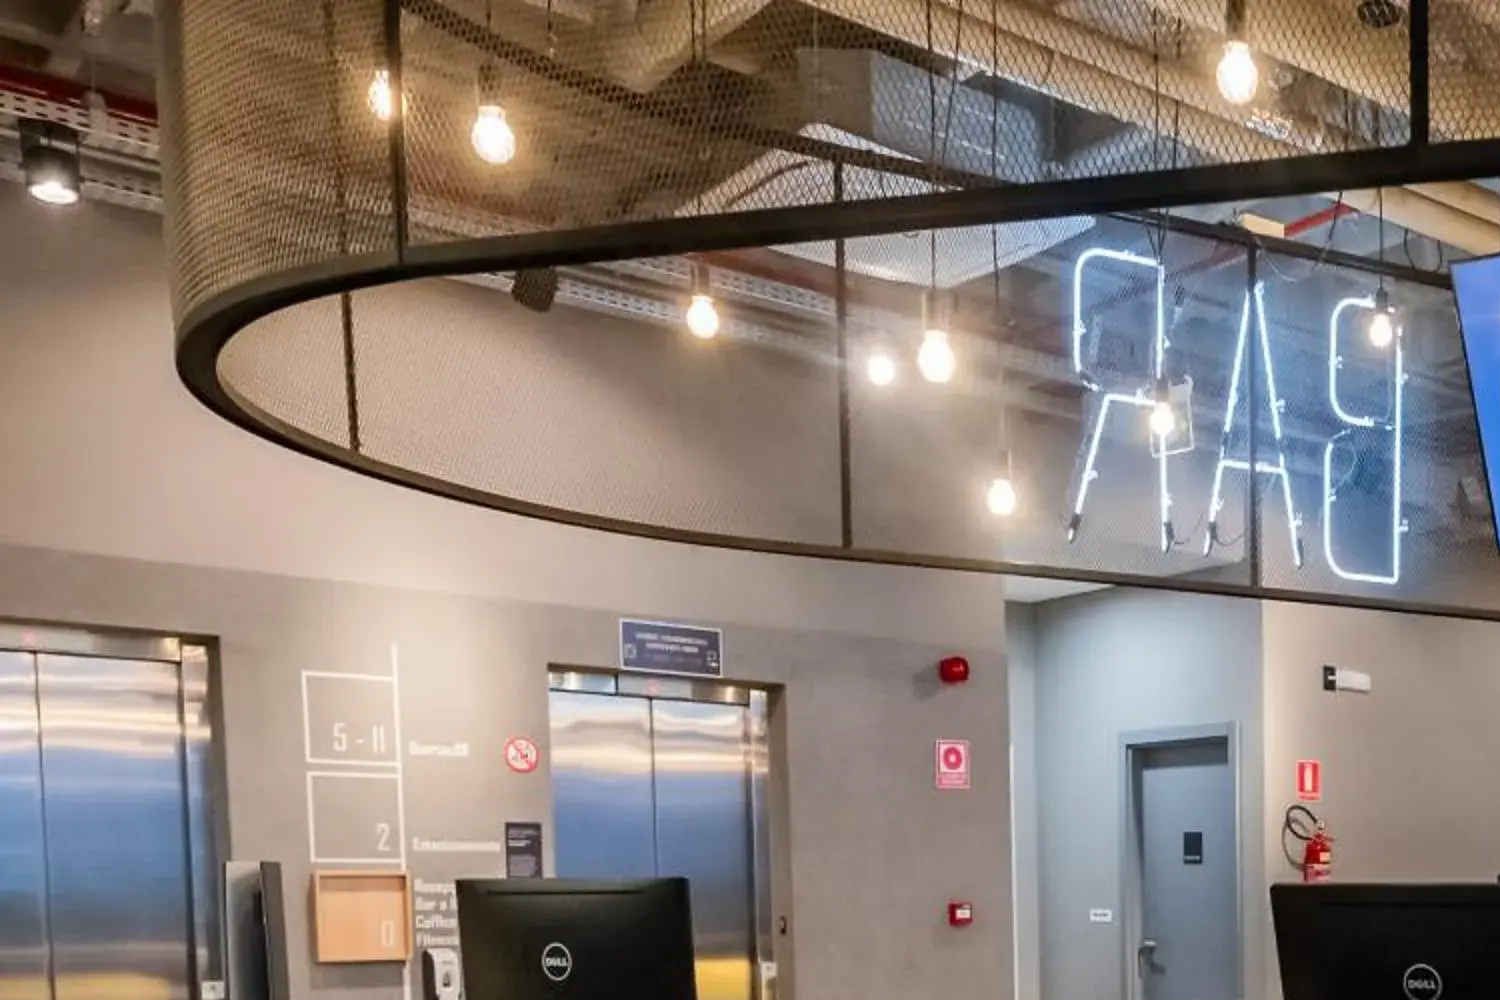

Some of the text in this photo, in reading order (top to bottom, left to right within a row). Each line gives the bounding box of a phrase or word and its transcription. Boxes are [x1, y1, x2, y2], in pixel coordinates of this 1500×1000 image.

[333, 722, 347, 752] 5
[375, 822, 391, 851] 2
[380, 921, 394, 947] 0
